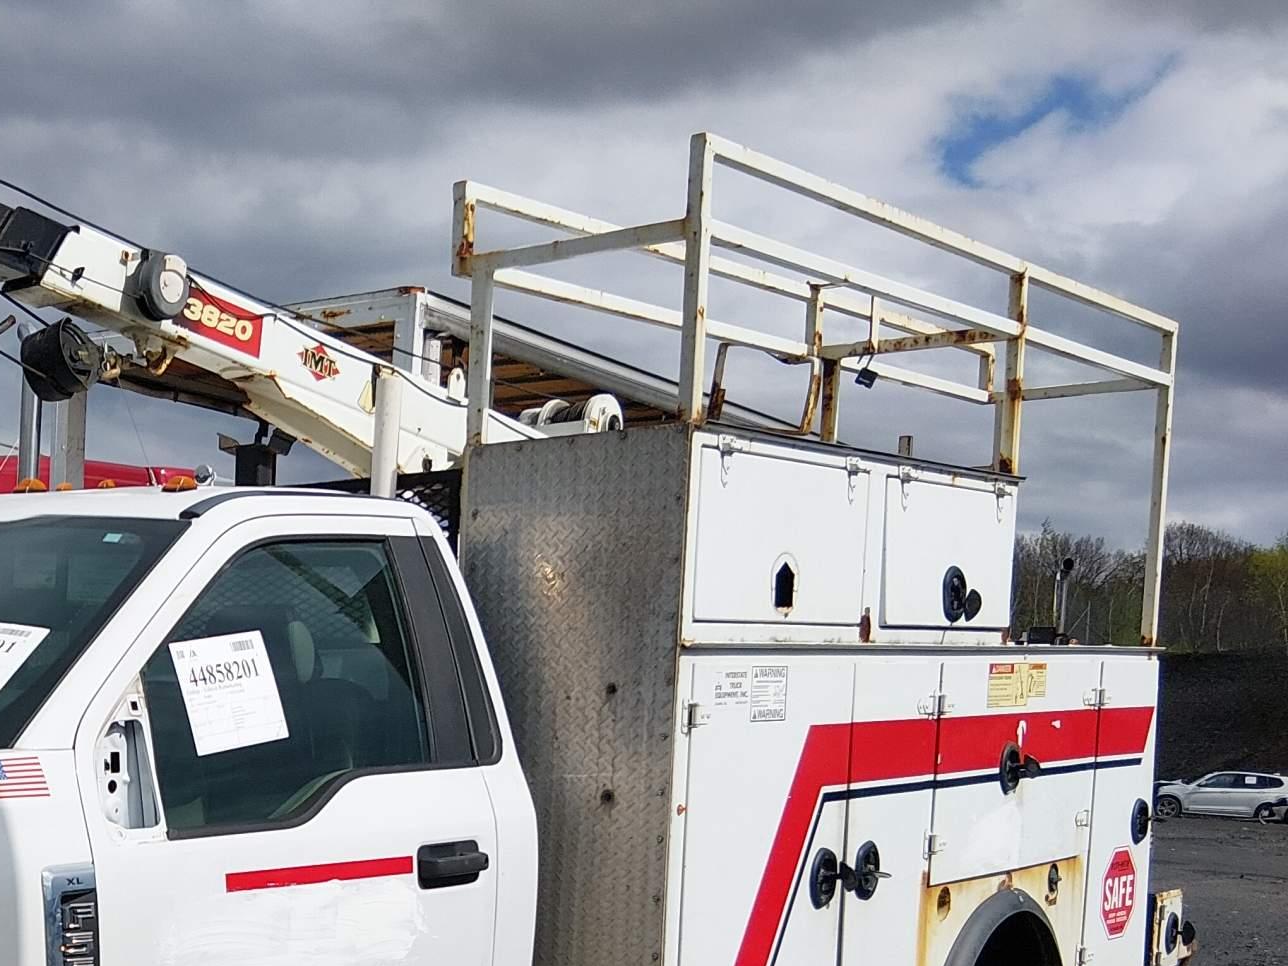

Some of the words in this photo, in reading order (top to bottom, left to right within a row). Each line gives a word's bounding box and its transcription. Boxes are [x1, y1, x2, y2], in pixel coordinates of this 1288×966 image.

[183, 296, 253, 341] 3820
[302, 348, 337, 378] IMT
[189, 658, 260, 687] 44858201
[759, 668, 786, 679] WARNING
[756, 708, 784, 720] WARNING
[66, 877, 83, 886] XL
[1103, 874, 1134, 912] SAFE
